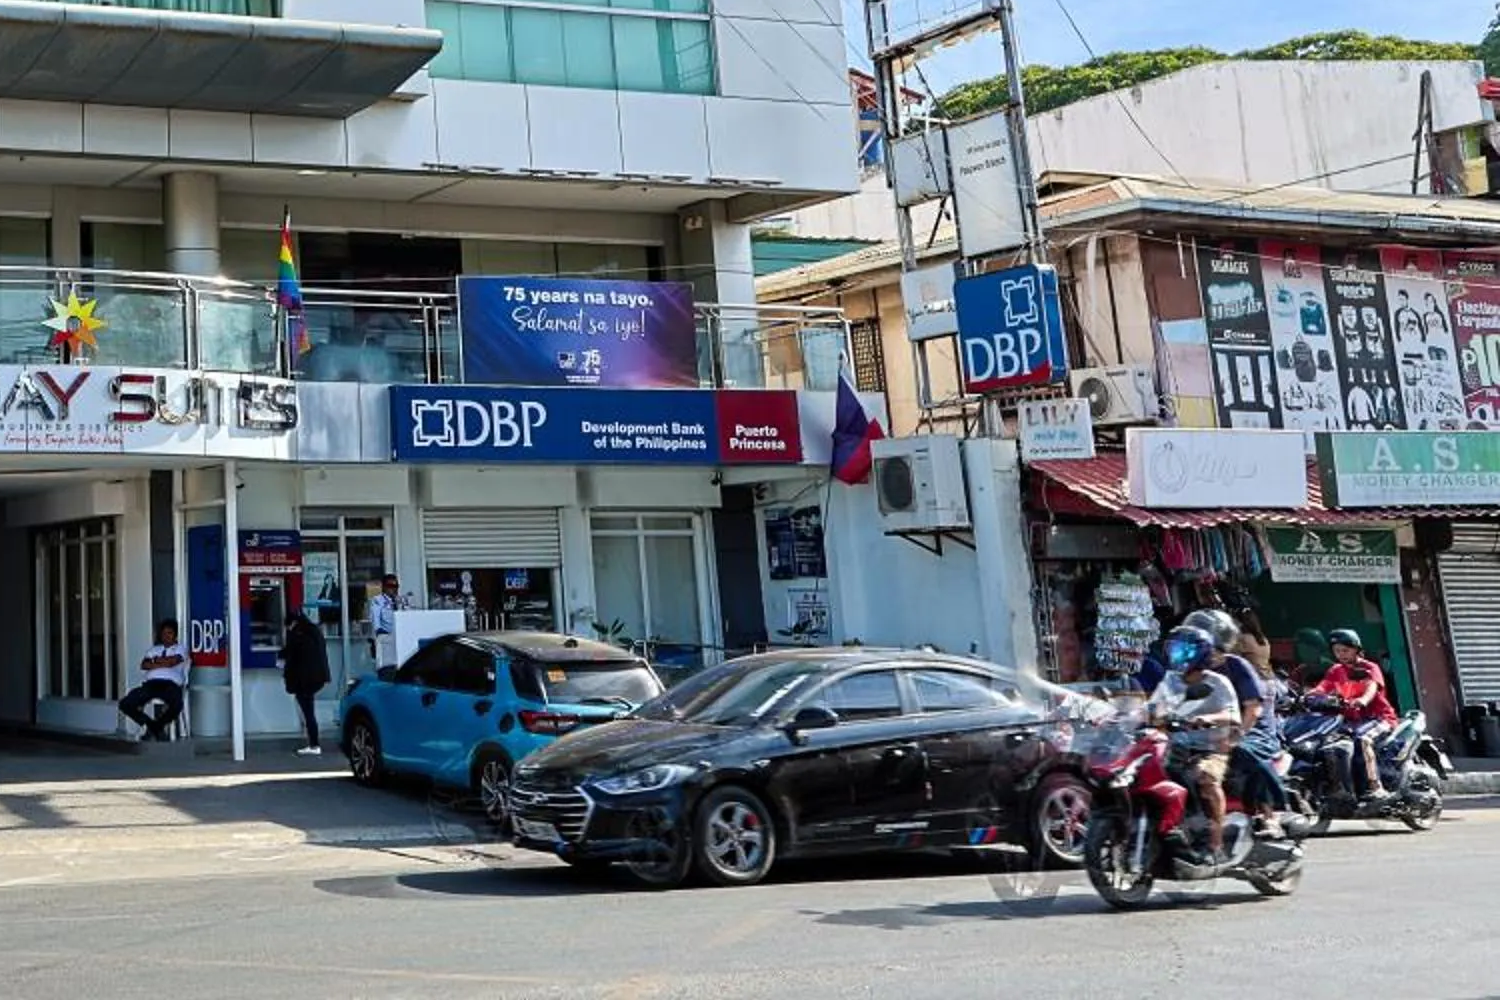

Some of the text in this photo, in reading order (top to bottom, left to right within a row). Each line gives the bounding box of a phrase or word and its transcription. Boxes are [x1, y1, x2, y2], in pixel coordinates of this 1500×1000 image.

[503, 287, 654, 309] 75 years na tayo.
[511, 305, 584, 334] Salamat
[588, 317, 609, 335] sa
[965, 328, 1041, 383] DBP
[78, 423, 144, 433] DISTRICT
[457, 399, 548, 448] DBP
[581, 420, 705, 438] Development Bank
[734, 423, 779, 438] Puerto
[593, 436, 707, 451] of the Philippines
[729, 437, 787, 451] Princesa
[191, 619, 223, 654] DBP
